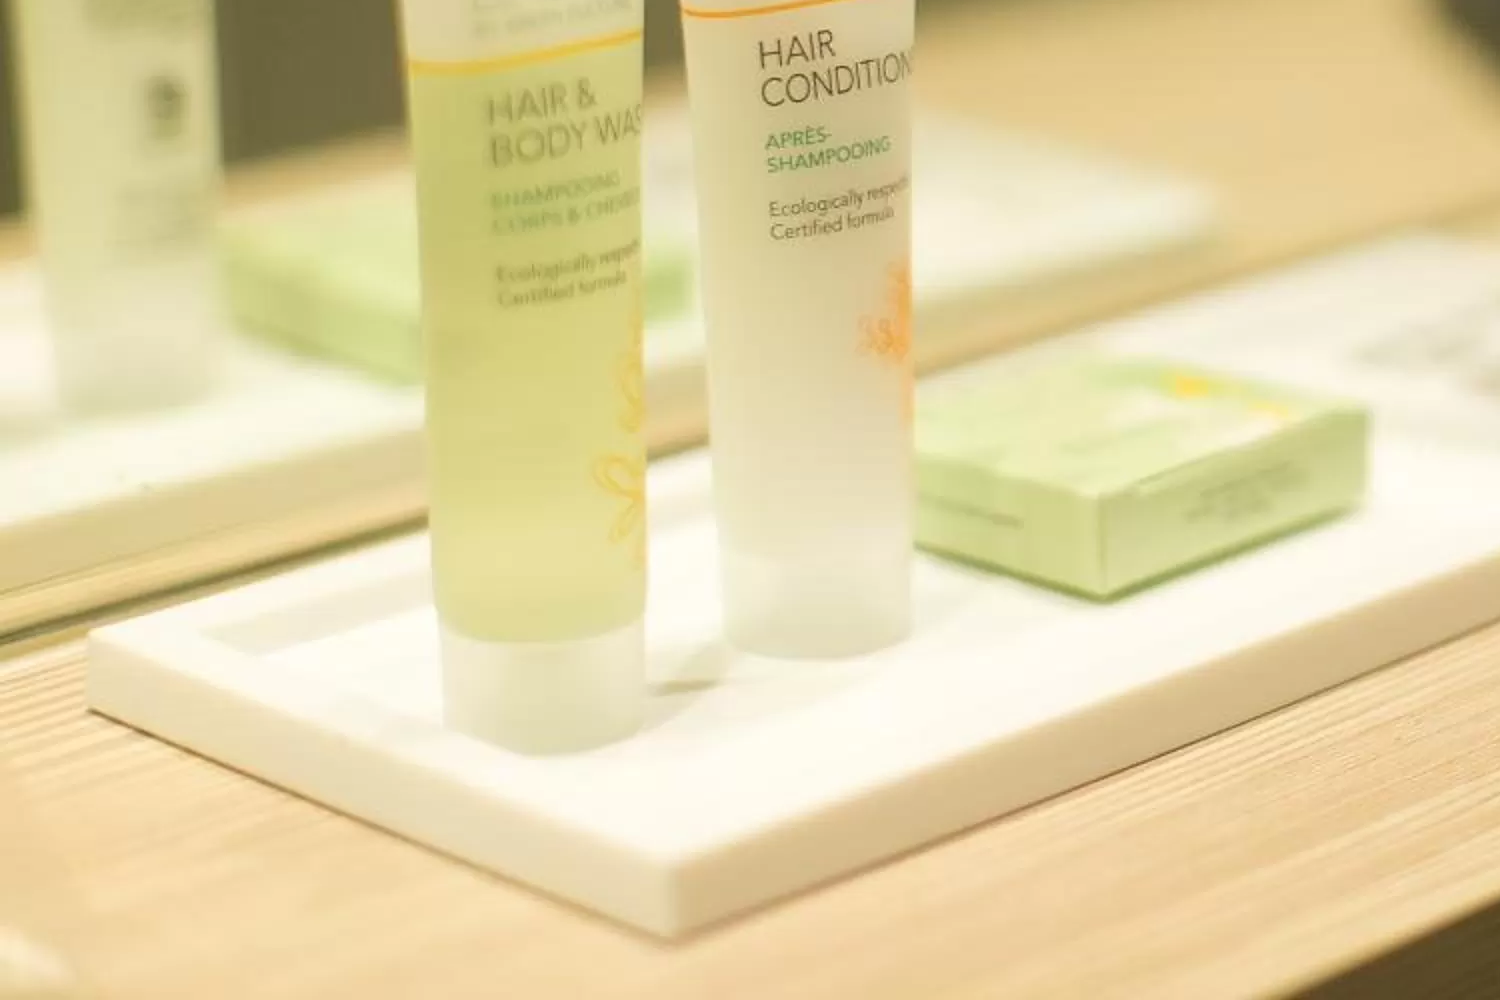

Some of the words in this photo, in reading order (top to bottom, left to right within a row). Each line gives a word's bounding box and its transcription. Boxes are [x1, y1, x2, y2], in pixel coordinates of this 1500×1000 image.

[758, 29, 837, 69] HAIR
[486, 79, 568, 126] HAIR
[576, 76, 598, 111] &
[489, 121, 588, 169] BODY
[767, 135, 891, 173] SHAMPOOING
[768, 190, 864, 226] Ecologically
[770, 215, 843, 240] Certified
